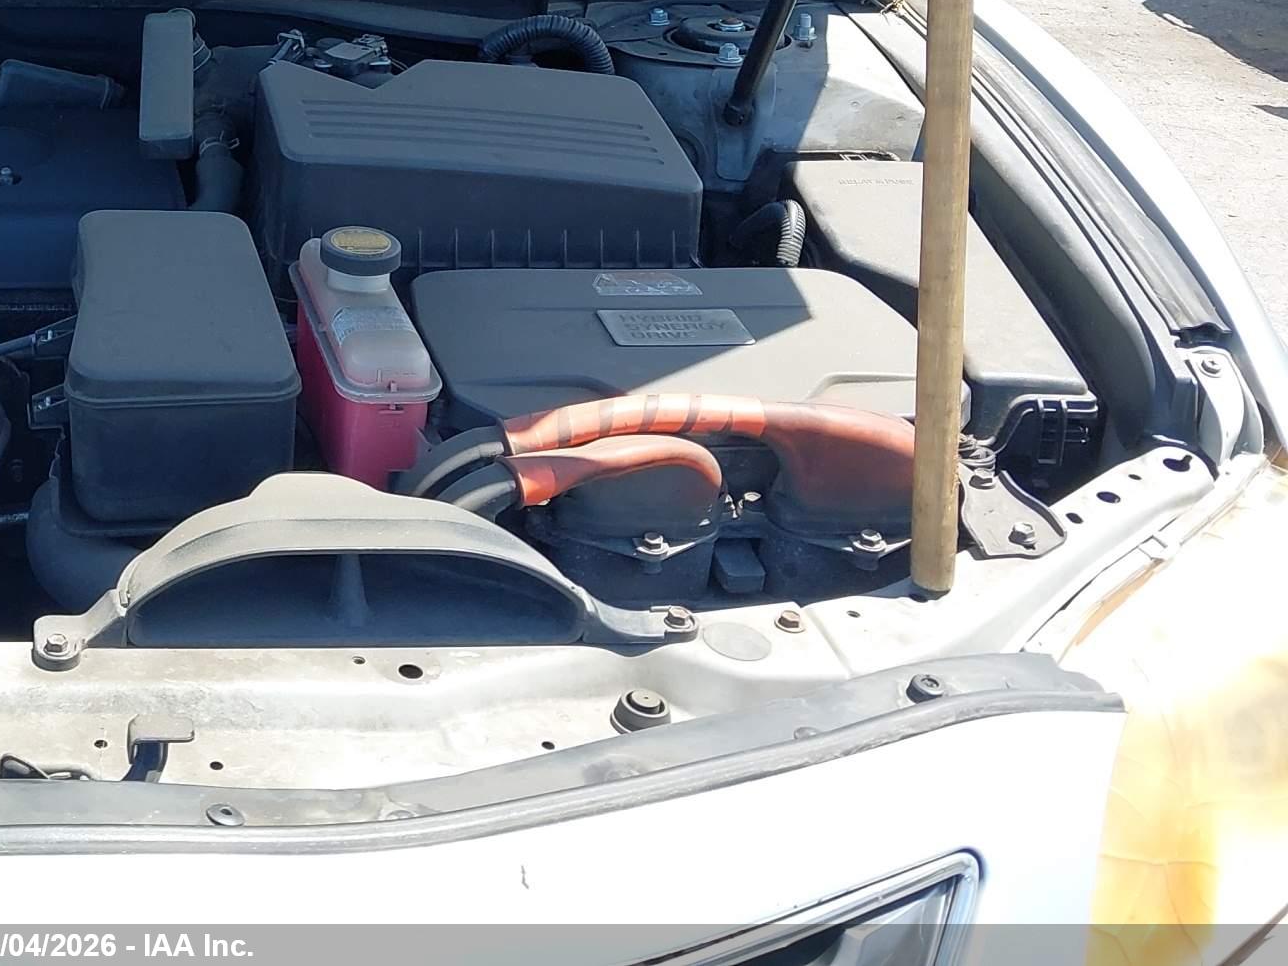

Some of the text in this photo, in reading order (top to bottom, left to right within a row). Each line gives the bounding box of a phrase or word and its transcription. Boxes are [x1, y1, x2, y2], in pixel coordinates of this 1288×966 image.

[618, 314, 703, 323] HYBRID
[625, 322, 727, 331] SYNERGY
[630, 331, 698, 339] DRIVE
